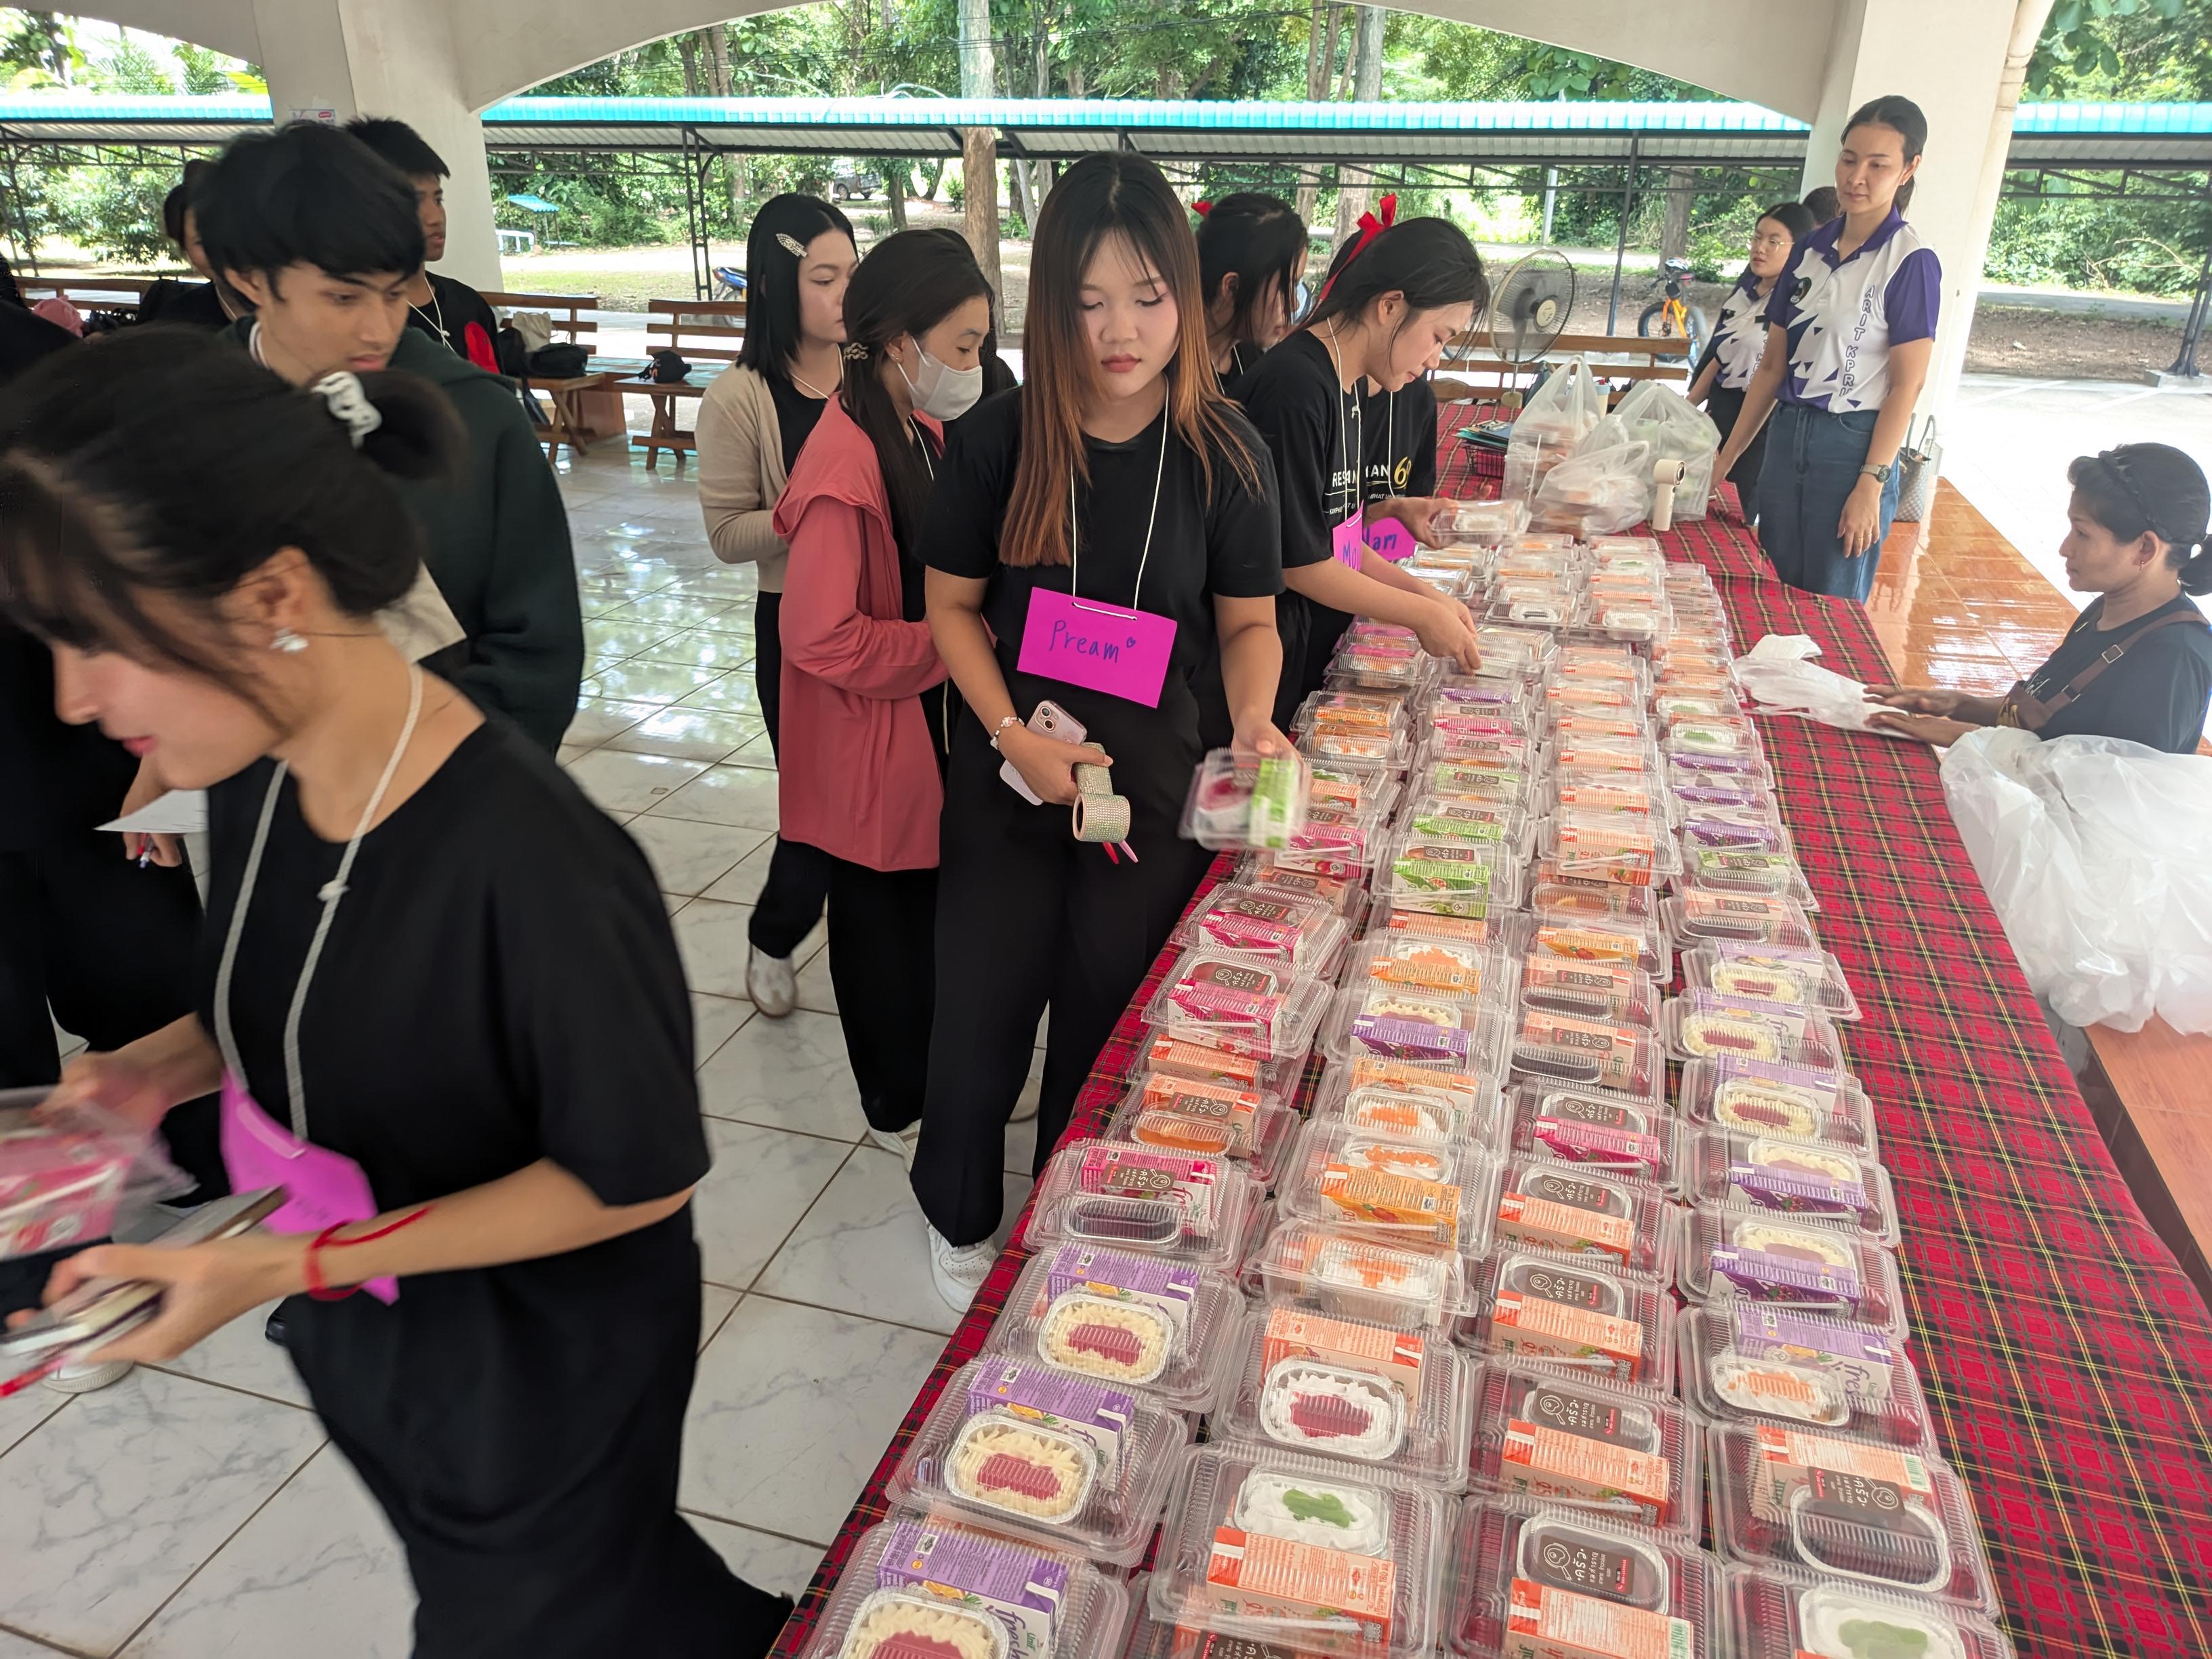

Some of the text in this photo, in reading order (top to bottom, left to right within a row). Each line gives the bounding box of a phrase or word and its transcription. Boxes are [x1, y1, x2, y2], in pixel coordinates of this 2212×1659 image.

[1853, 285, 1875, 341] ARIT
[1048, 619, 1119, 663] Pream
[1232, 972, 1242, 984] ครัว
[1199, 1099, 1208, 1111] ครัว
[1586, 1105, 1594, 1118] ครัว
[1137, 1171, 1147, 1185] ครัว
[1565, 1185, 1576, 1198] ครัว
[1554, 1279, 1565, 1296] ครัว
[1566, 1401, 1578, 1422] ครัว
[1854, 1479, 1869, 1504] ครัว
[1573, 1551, 1585, 1578] ครัว
[1027, 1632, 1036, 1652] Unif
